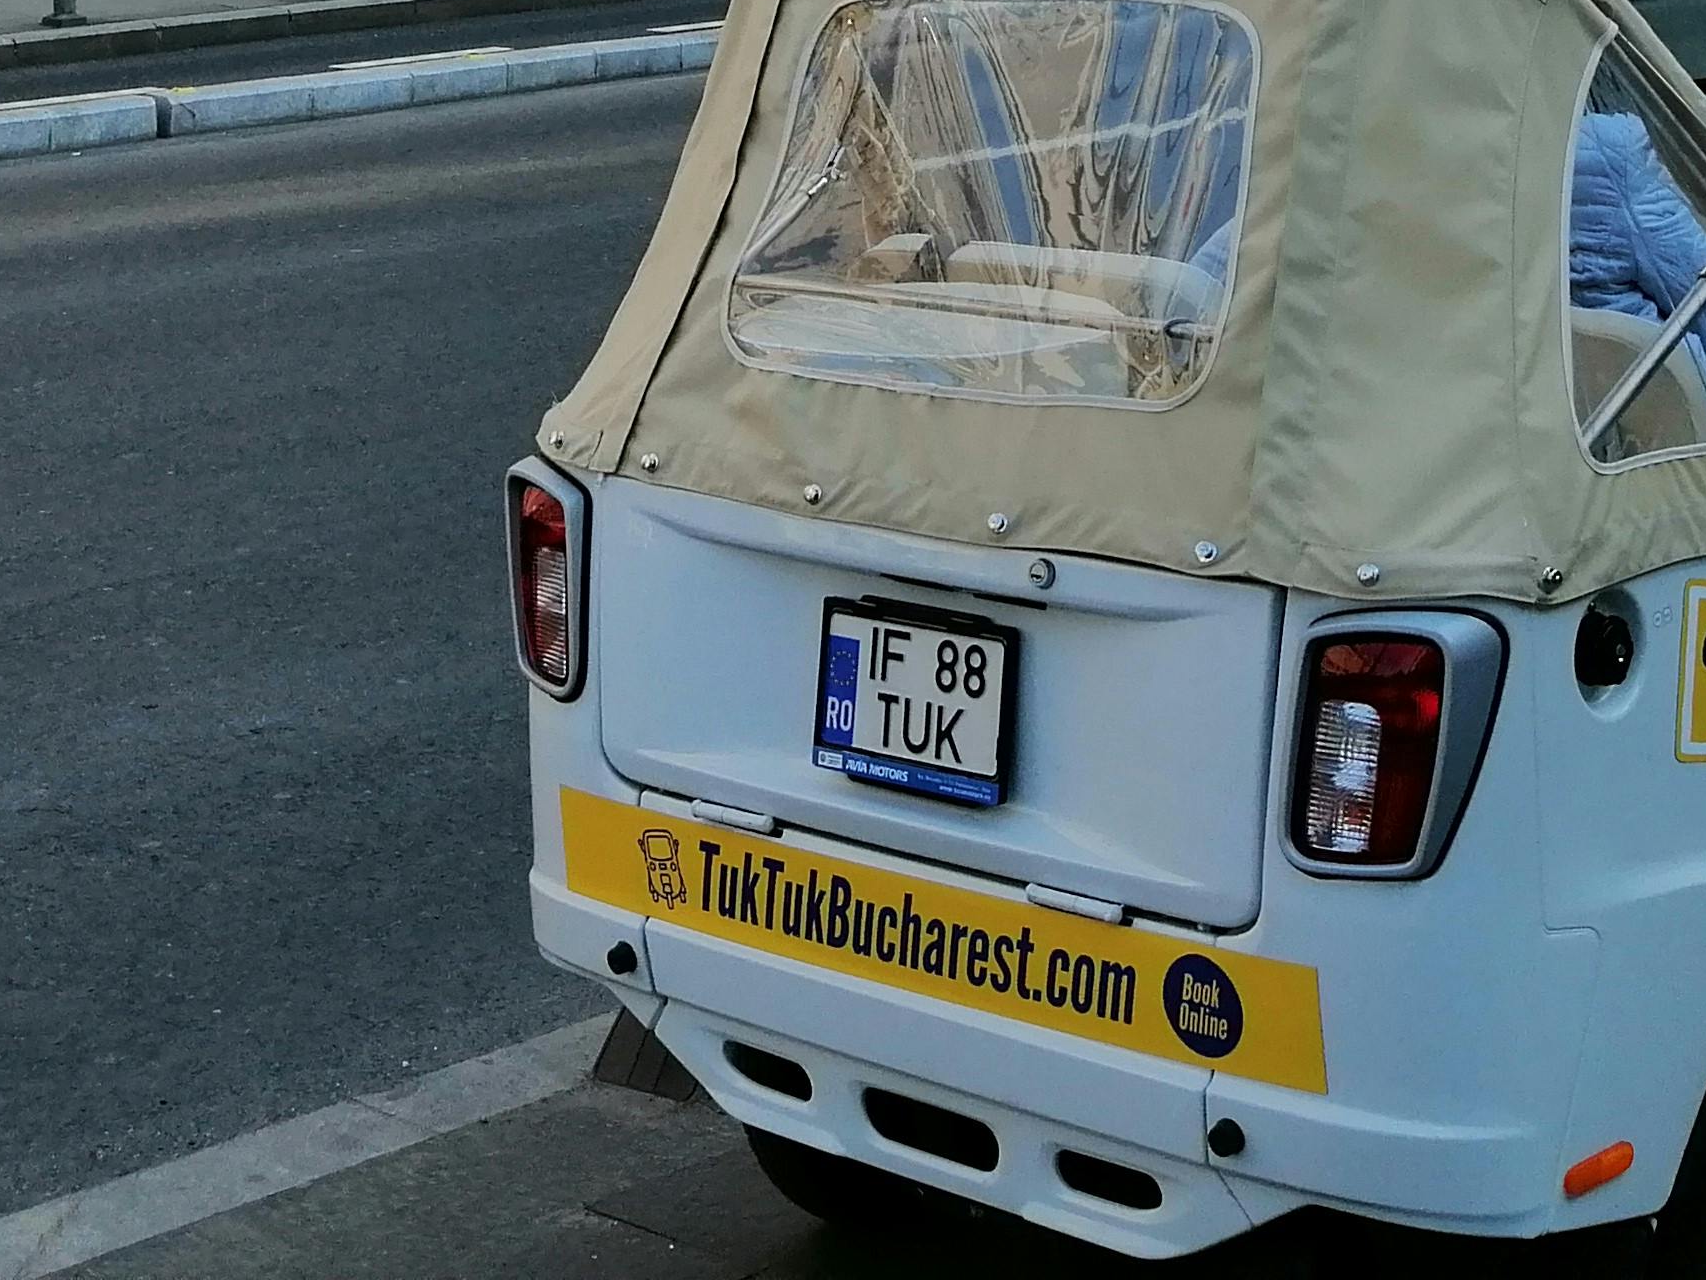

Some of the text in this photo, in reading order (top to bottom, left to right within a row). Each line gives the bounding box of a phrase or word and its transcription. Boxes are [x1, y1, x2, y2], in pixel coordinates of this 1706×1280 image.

[869, 626, 987, 699] IF 88
[825, 695, 853, 732] RO
[877, 691, 965, 764] TUK
[868, 763, 909, 782] MOTORS
[697, 839, 1137, 1026] TukTukBucharest.com
[1181, 971, 1221, 1010] Book
[1178, 1002, 1230, 1042] Online
